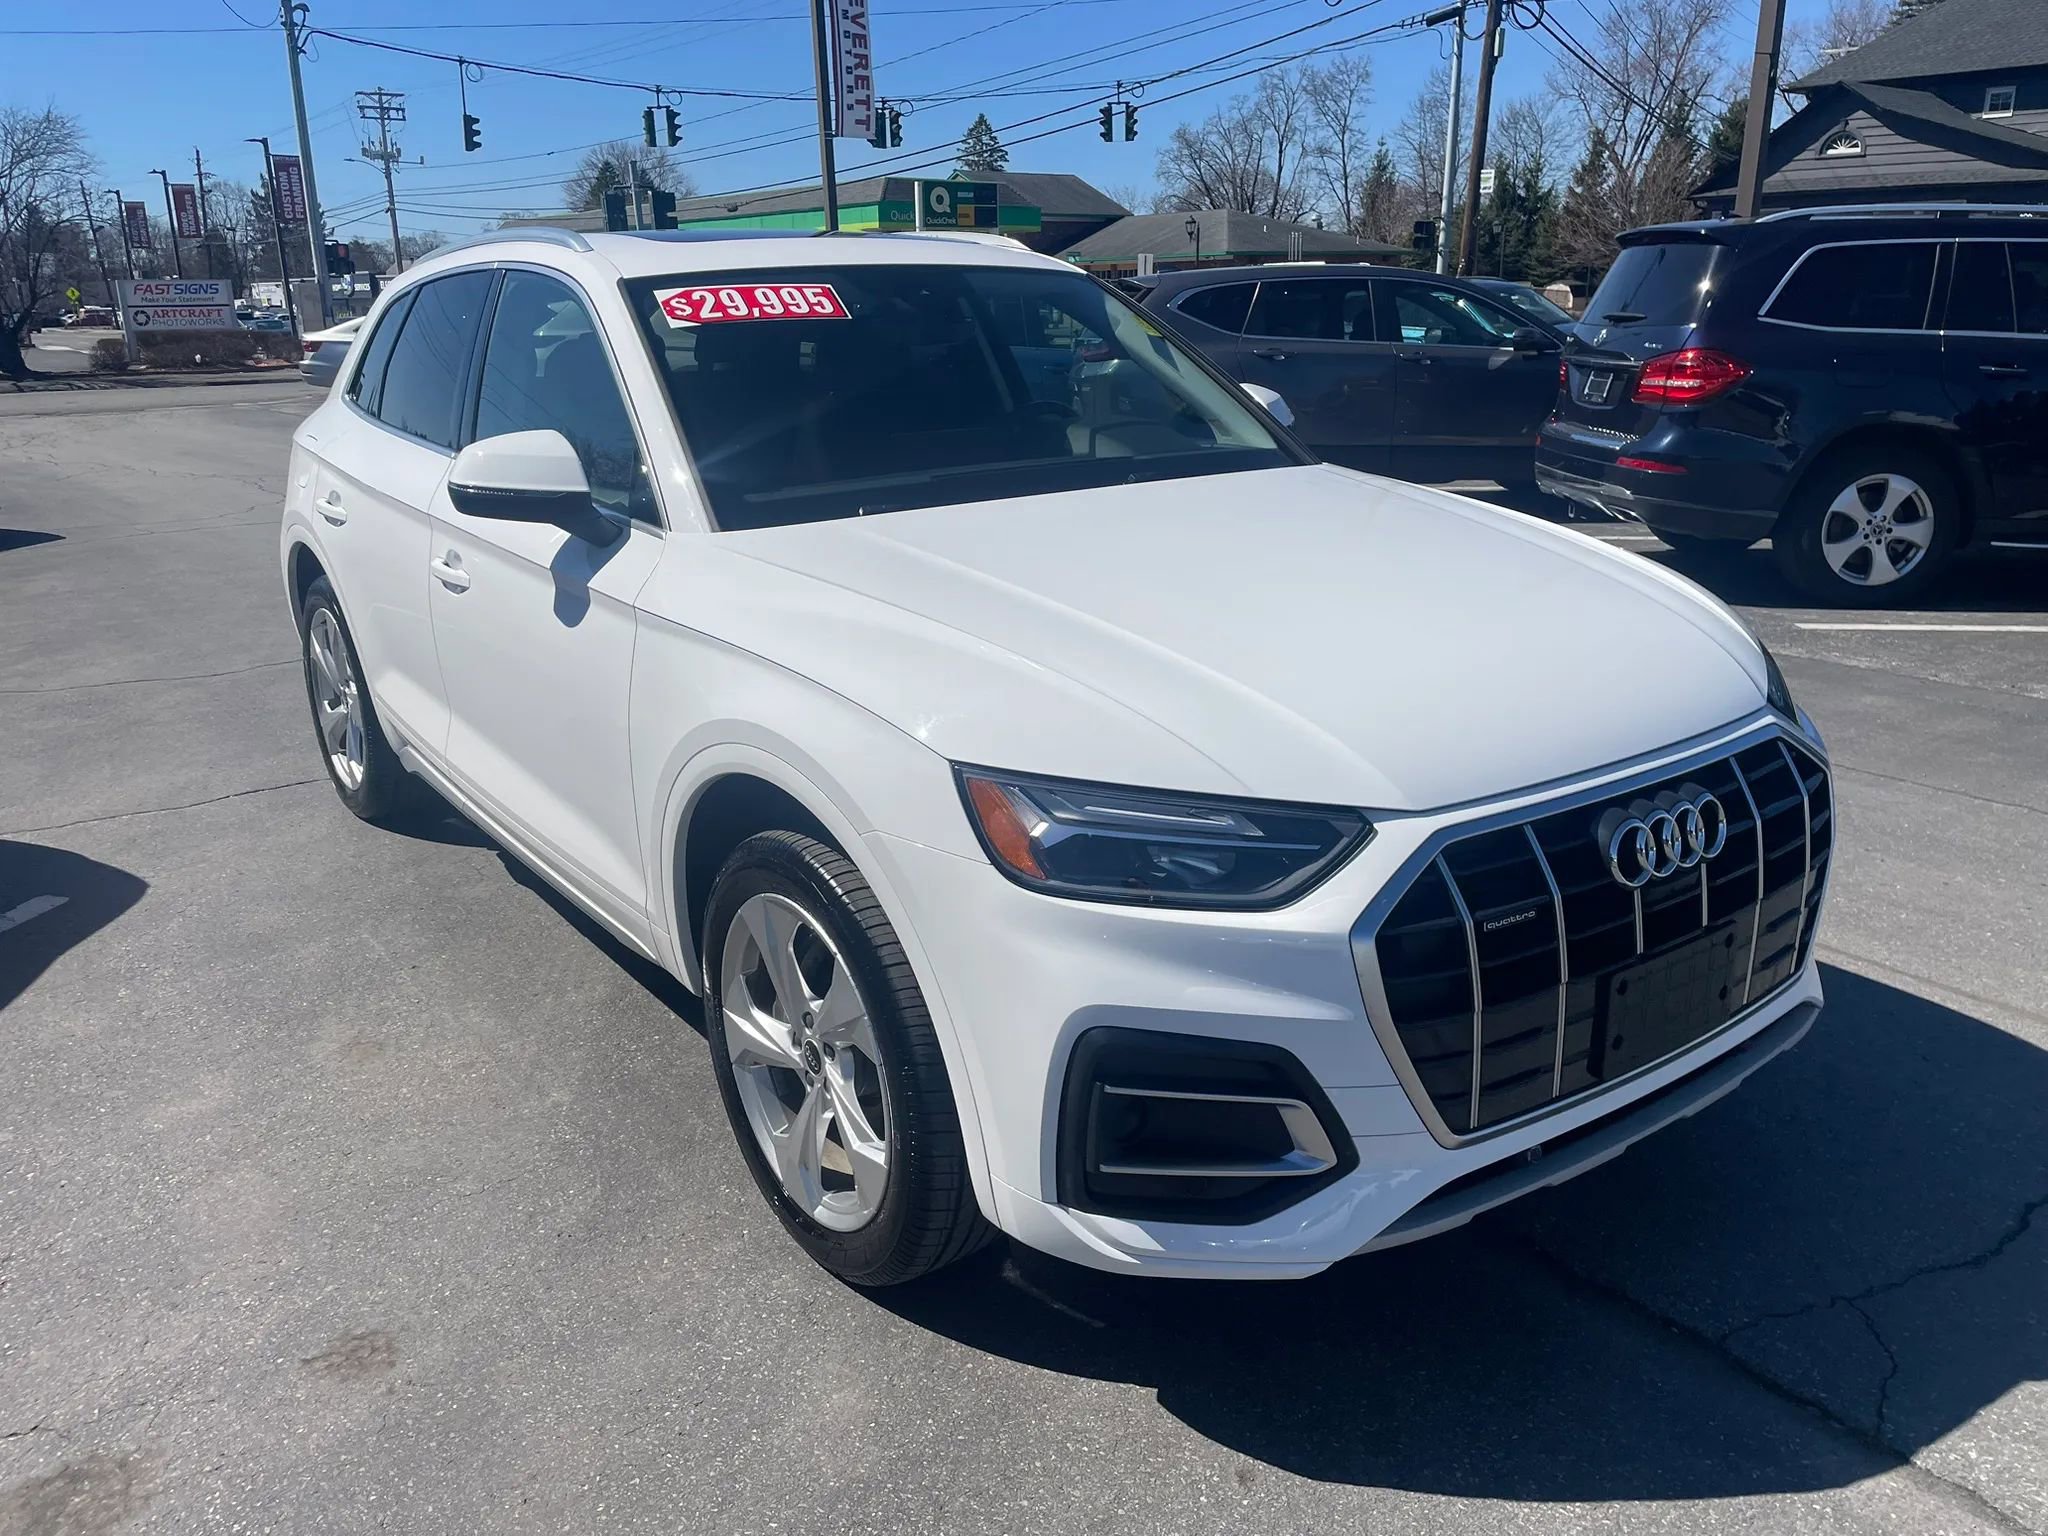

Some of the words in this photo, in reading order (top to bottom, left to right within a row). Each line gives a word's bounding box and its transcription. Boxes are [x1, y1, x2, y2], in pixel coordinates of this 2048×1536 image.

[841, 9, 855, 111] MOTORS
[278, 171, 294, 219] CUSTOM
[289, 167, 304, 219] FRAMING
[180, 211, 190, 236] VIDEO
[184, 194, 197, 236] TRANSFER
[925, 216, 956, 225] QuickChek
[134, 283, 219, 295] FASTSIGNS
[141, 296, 160, 304] Make
[179, 295, 215, 303] Statement
[152, 308, 223, 319] ARTCRAFT
[669, 287, 834, 319] $29,995
[152, 318, 225, 327] PHOTOWORKS
[1487, 910, 1536, 929] quattro
